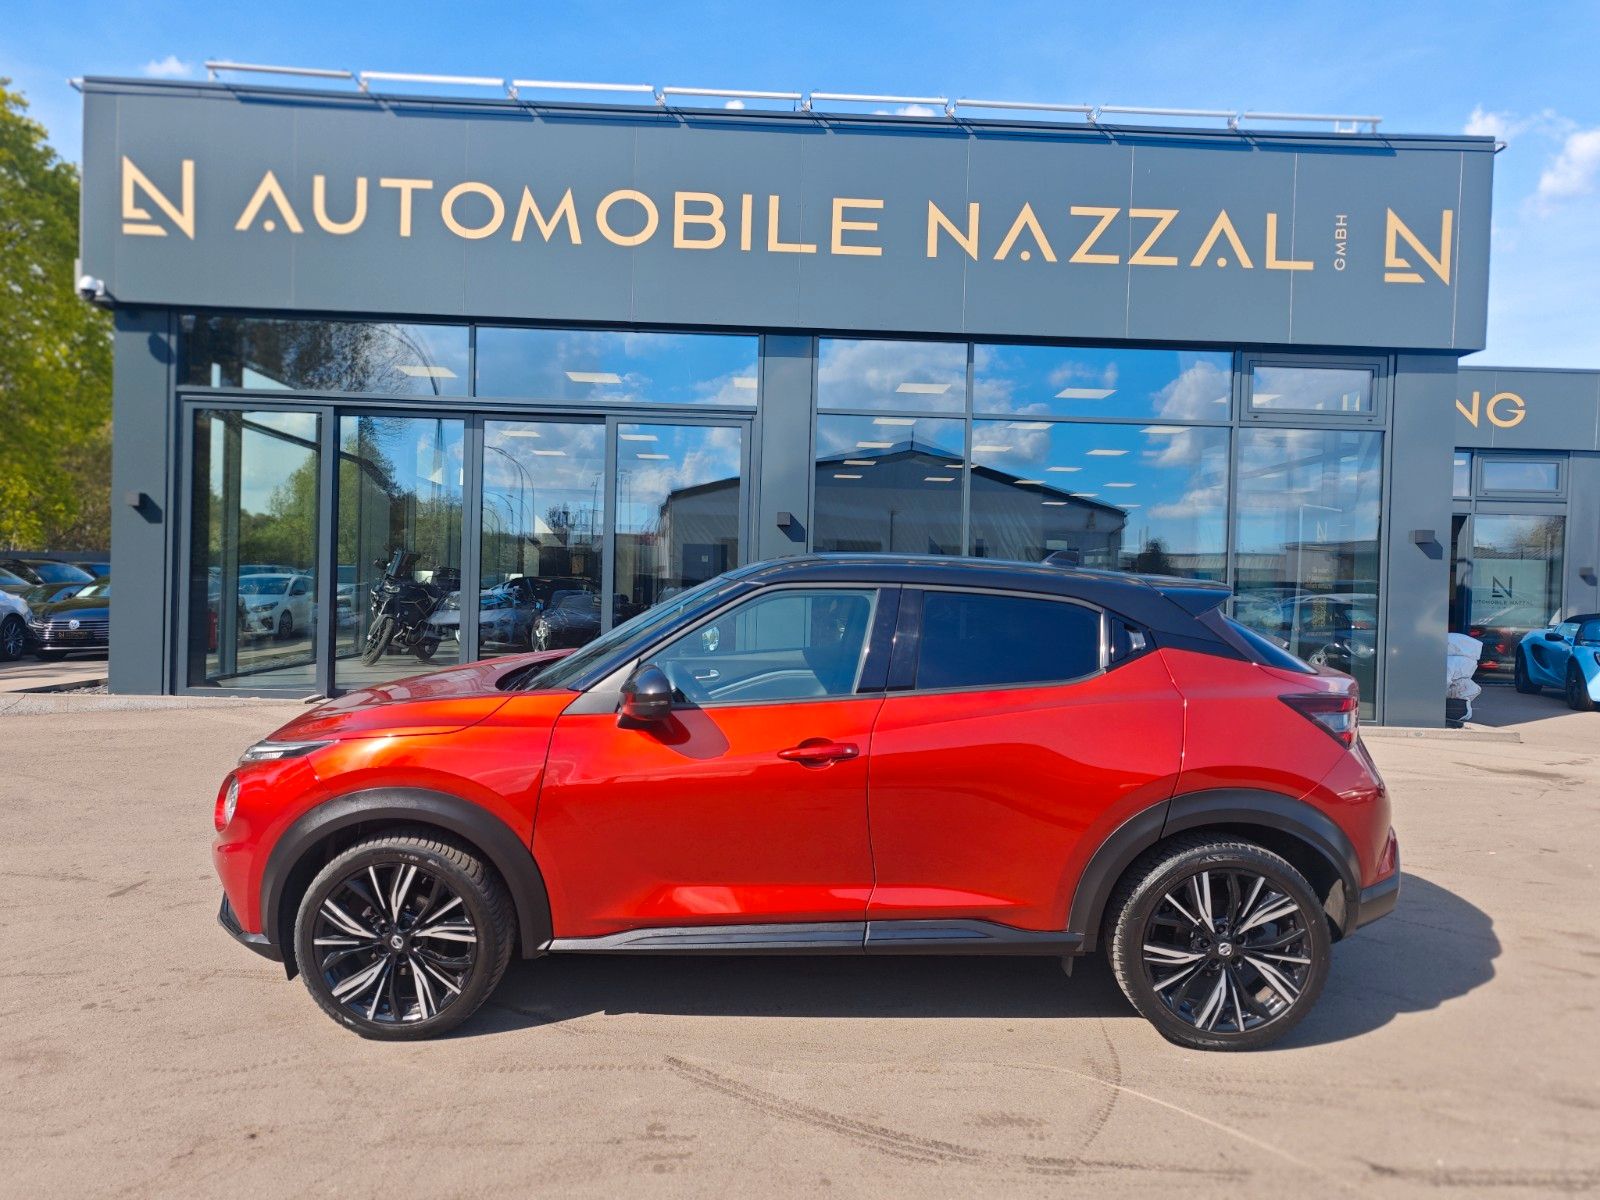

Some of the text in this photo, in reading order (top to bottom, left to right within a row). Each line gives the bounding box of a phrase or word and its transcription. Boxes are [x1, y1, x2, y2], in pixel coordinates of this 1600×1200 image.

[234, 170, 885, 257] AUTOMOBILE
[926, 200, 1315, 271] NAZZAL
[1334, 214, 1348, 271] GMBH
